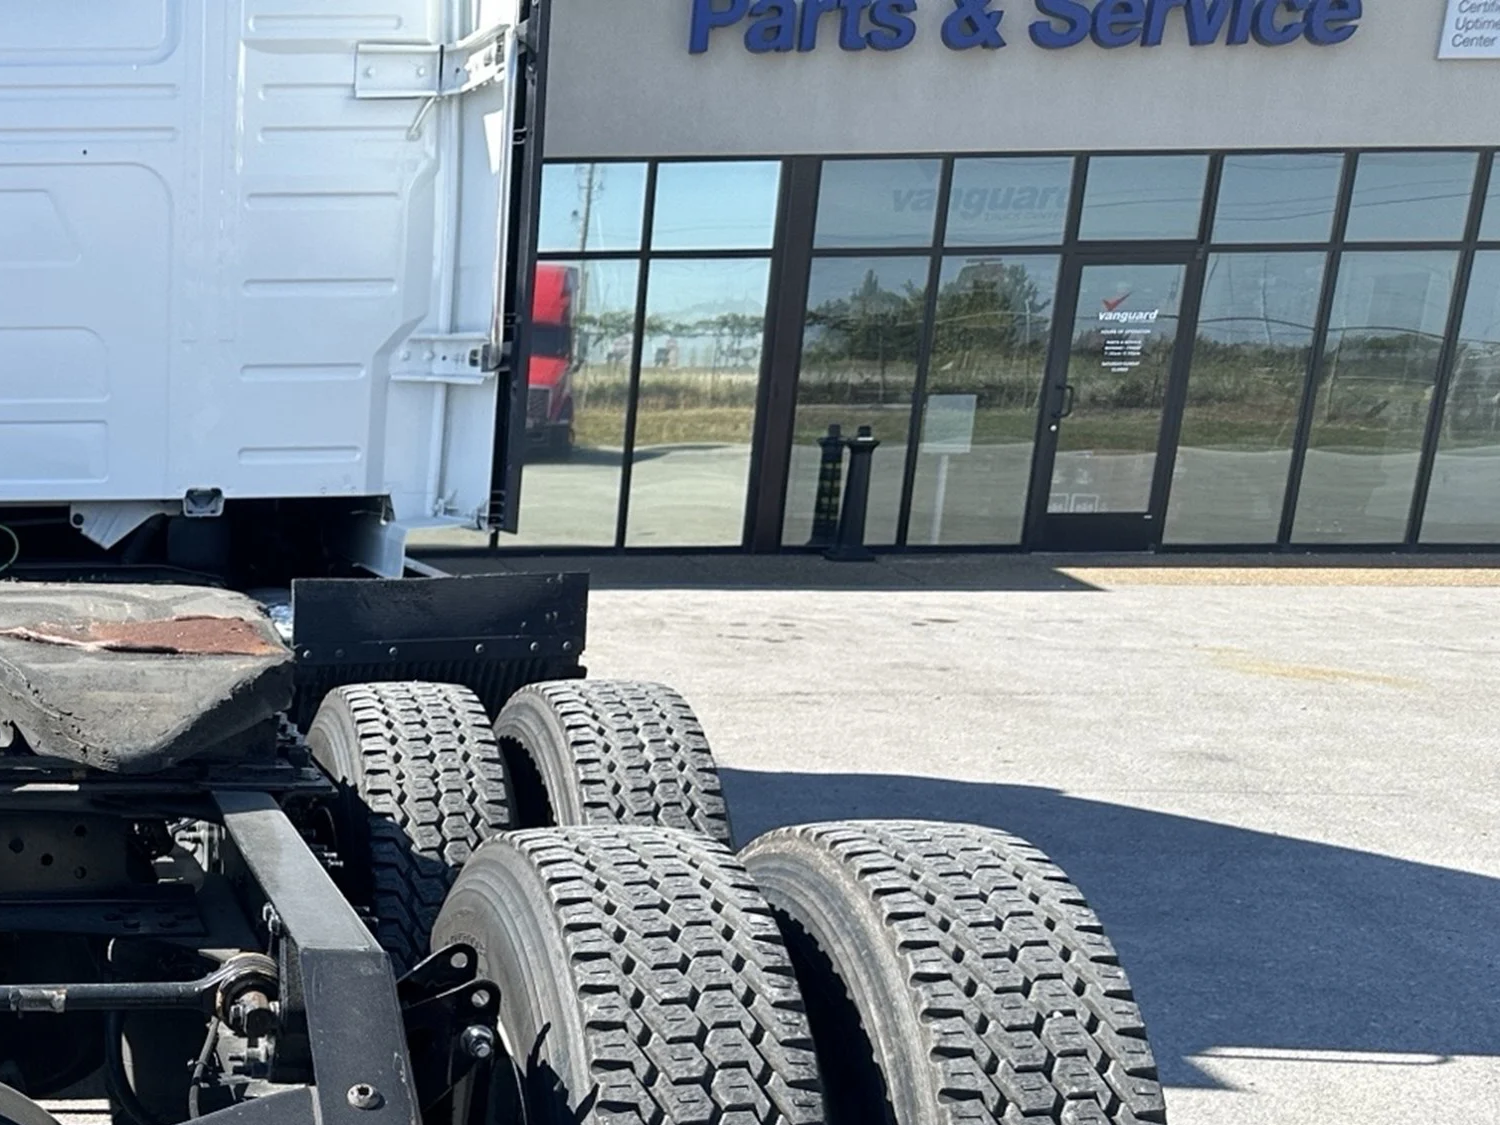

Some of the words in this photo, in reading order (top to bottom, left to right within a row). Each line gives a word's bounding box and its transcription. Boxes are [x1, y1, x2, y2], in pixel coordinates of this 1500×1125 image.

[688, 0, 918, 54] Parts
[940, 0, 1007, 51] &
[1028, 0, 1363, 50] Service
[1451, 33, 1498, 48] Center
[1099, 309, 1159, 323] vanguard
